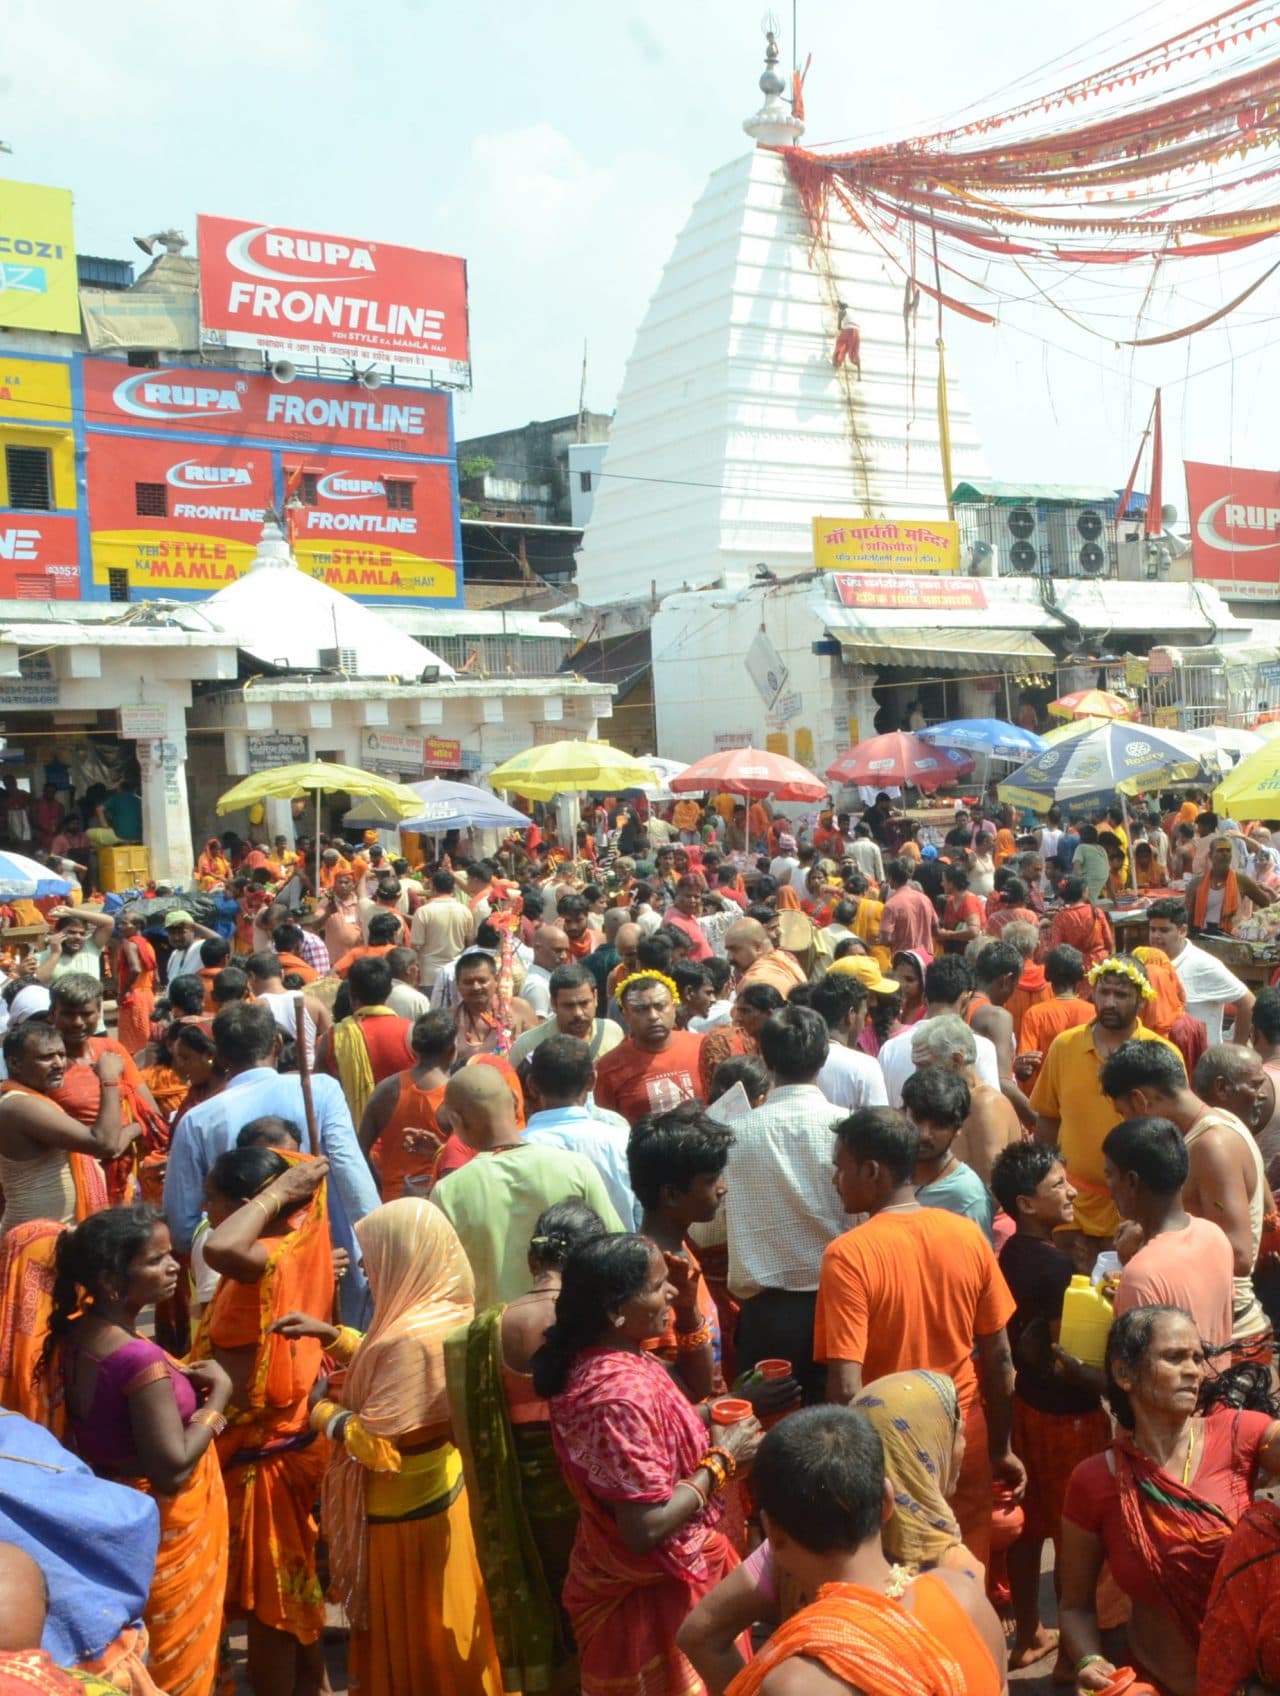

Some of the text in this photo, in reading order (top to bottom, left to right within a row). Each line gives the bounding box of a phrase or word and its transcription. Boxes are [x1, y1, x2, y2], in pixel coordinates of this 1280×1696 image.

[265, 233, 376, 272] RUPA
[228, 281, 446, 341] FRONTLINE
[347, 331, 379, 344] STYLE
[392, 338, 429, 350] MAMLA
[144, 383, 425, 434] RUPA FRONTLINE
[185, 465, 252, 485] RUPA
[333, 477, 386, 495] RUPA
[173, 504, 266, 523] FRONTLINE
[307, 511, 417, 534] FRONTLINE
[850, 524, 899, 540] पार्वती
[137, 541, 227, 560] YEH STYLE
[312, 548, 392, 567] YEH STYLE
[135, 559, 238, 581] KA MAMLA
[325, 567, 401, 586] MAMLA
[1124, 752, 1165, 767] Rotary
